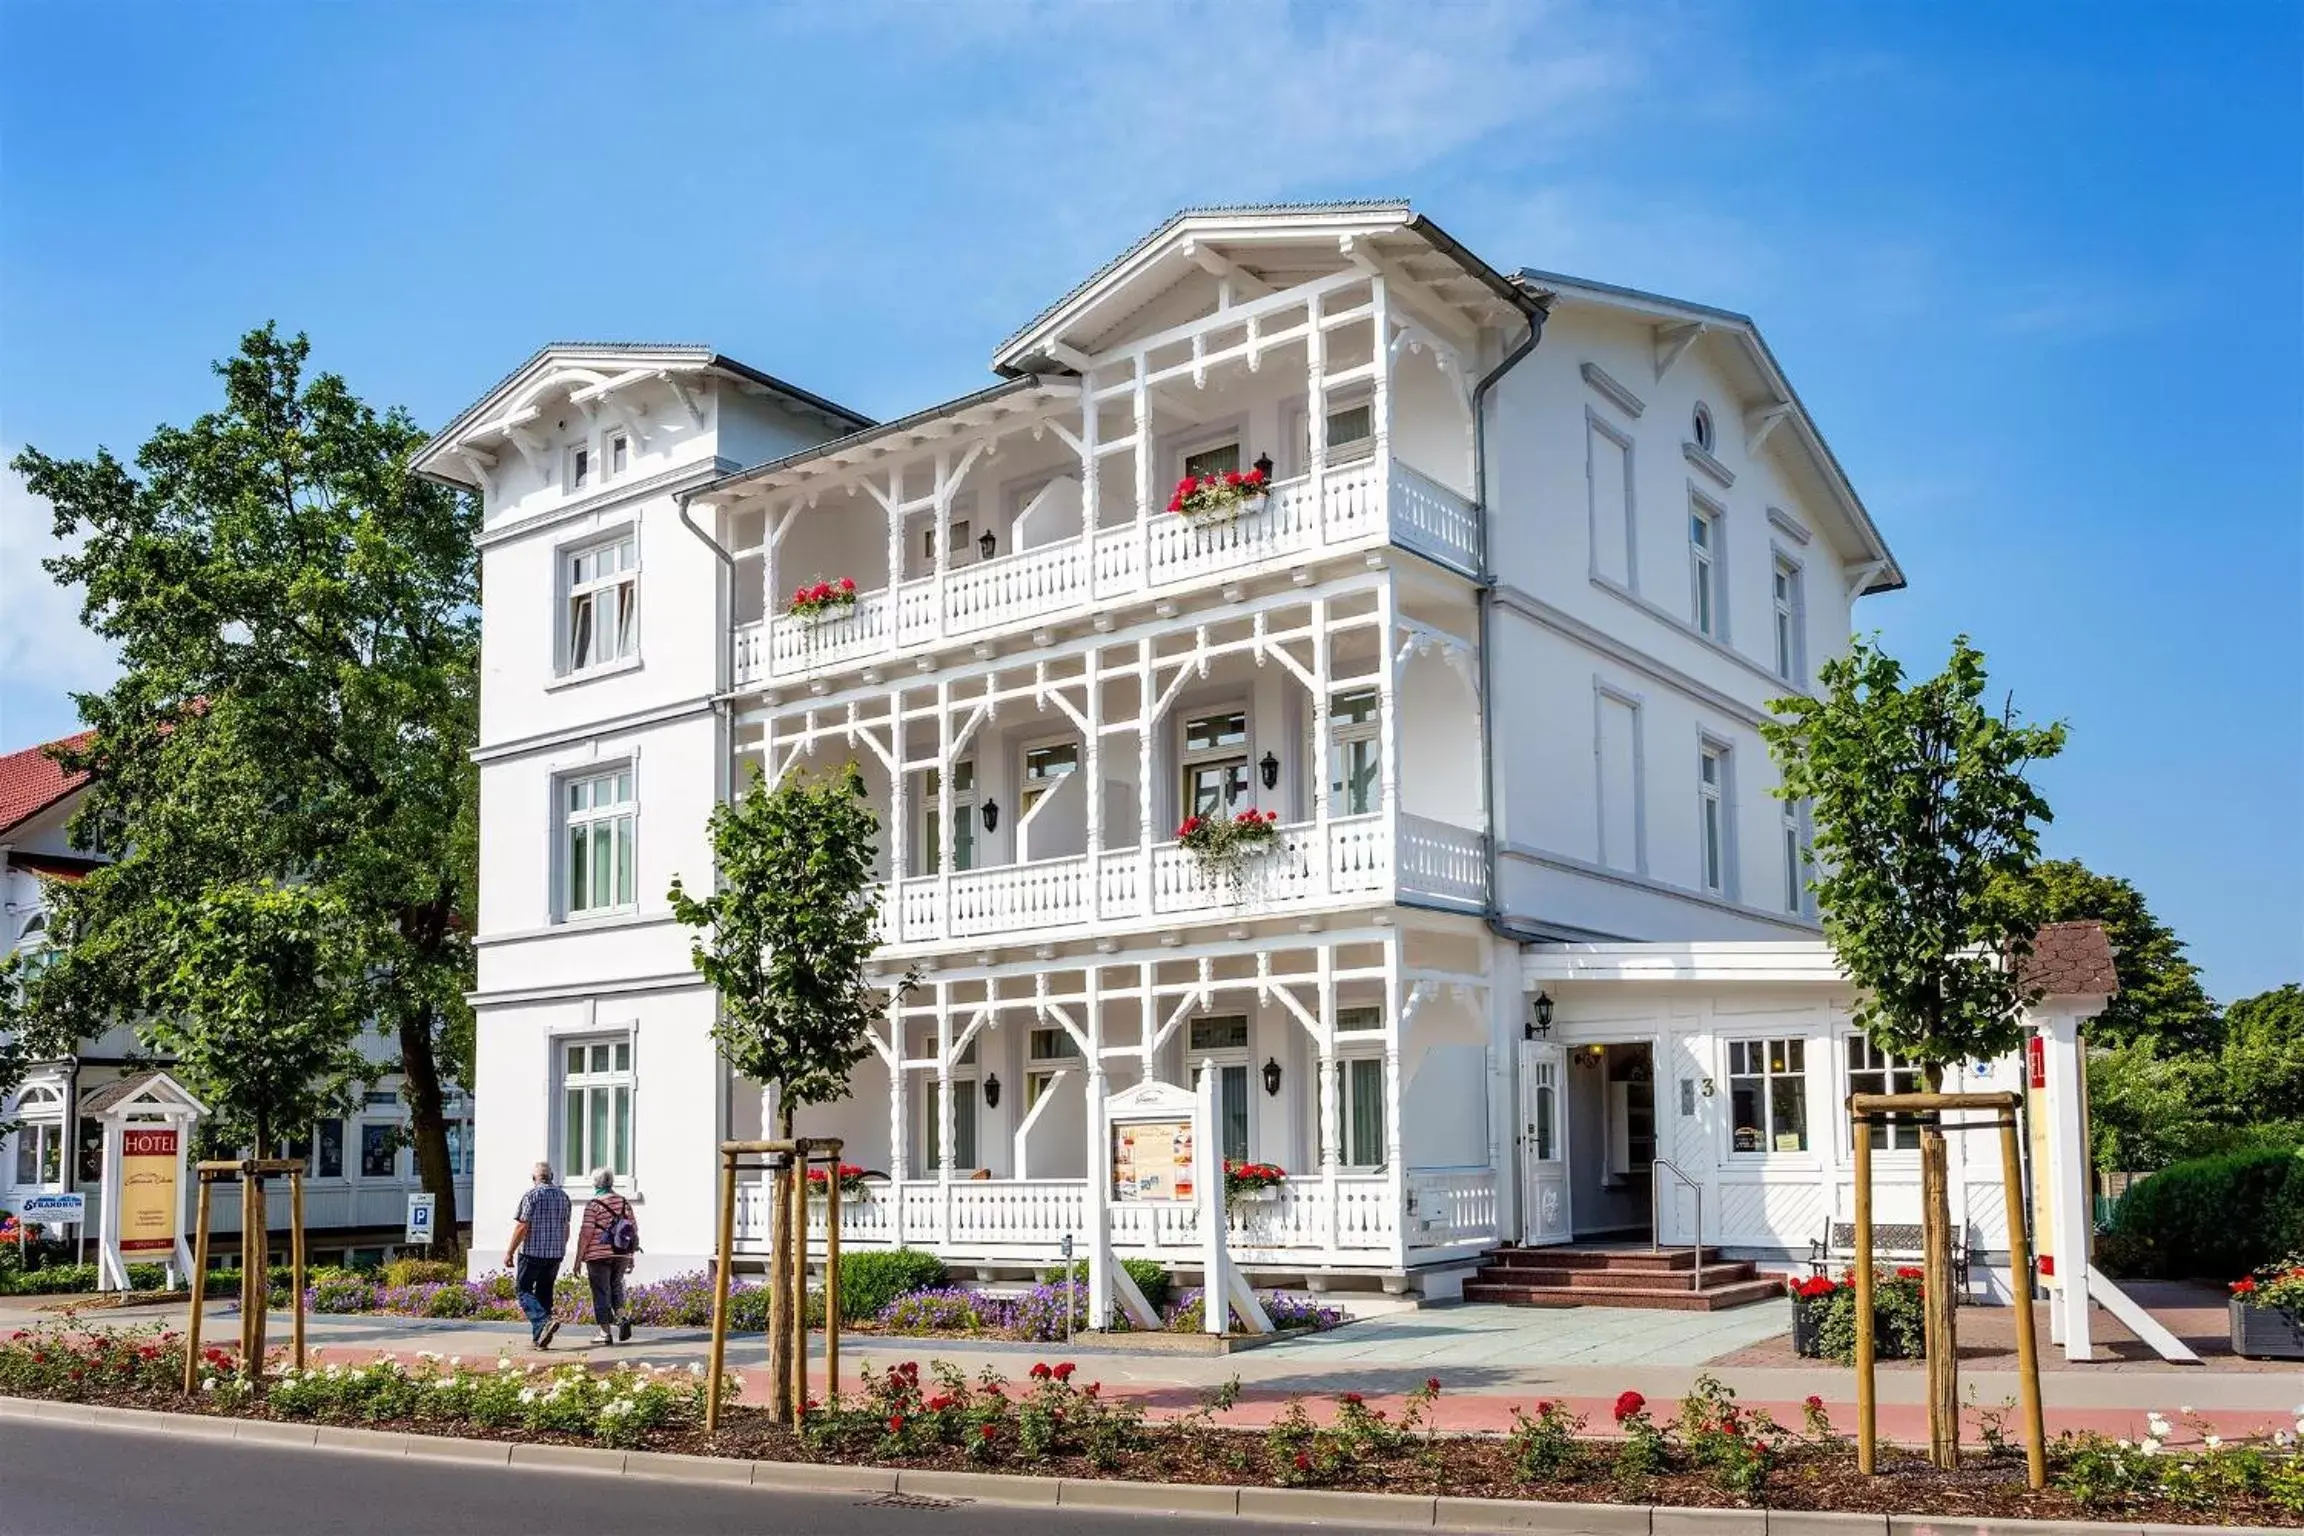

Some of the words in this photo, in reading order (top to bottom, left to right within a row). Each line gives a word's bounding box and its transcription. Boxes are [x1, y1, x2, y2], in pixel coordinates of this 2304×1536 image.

[1701, 1078, 1715, 1097] 3
[125, 1136, 177, 1151] HOTEL
[417, 1210, 426, 1223] P
